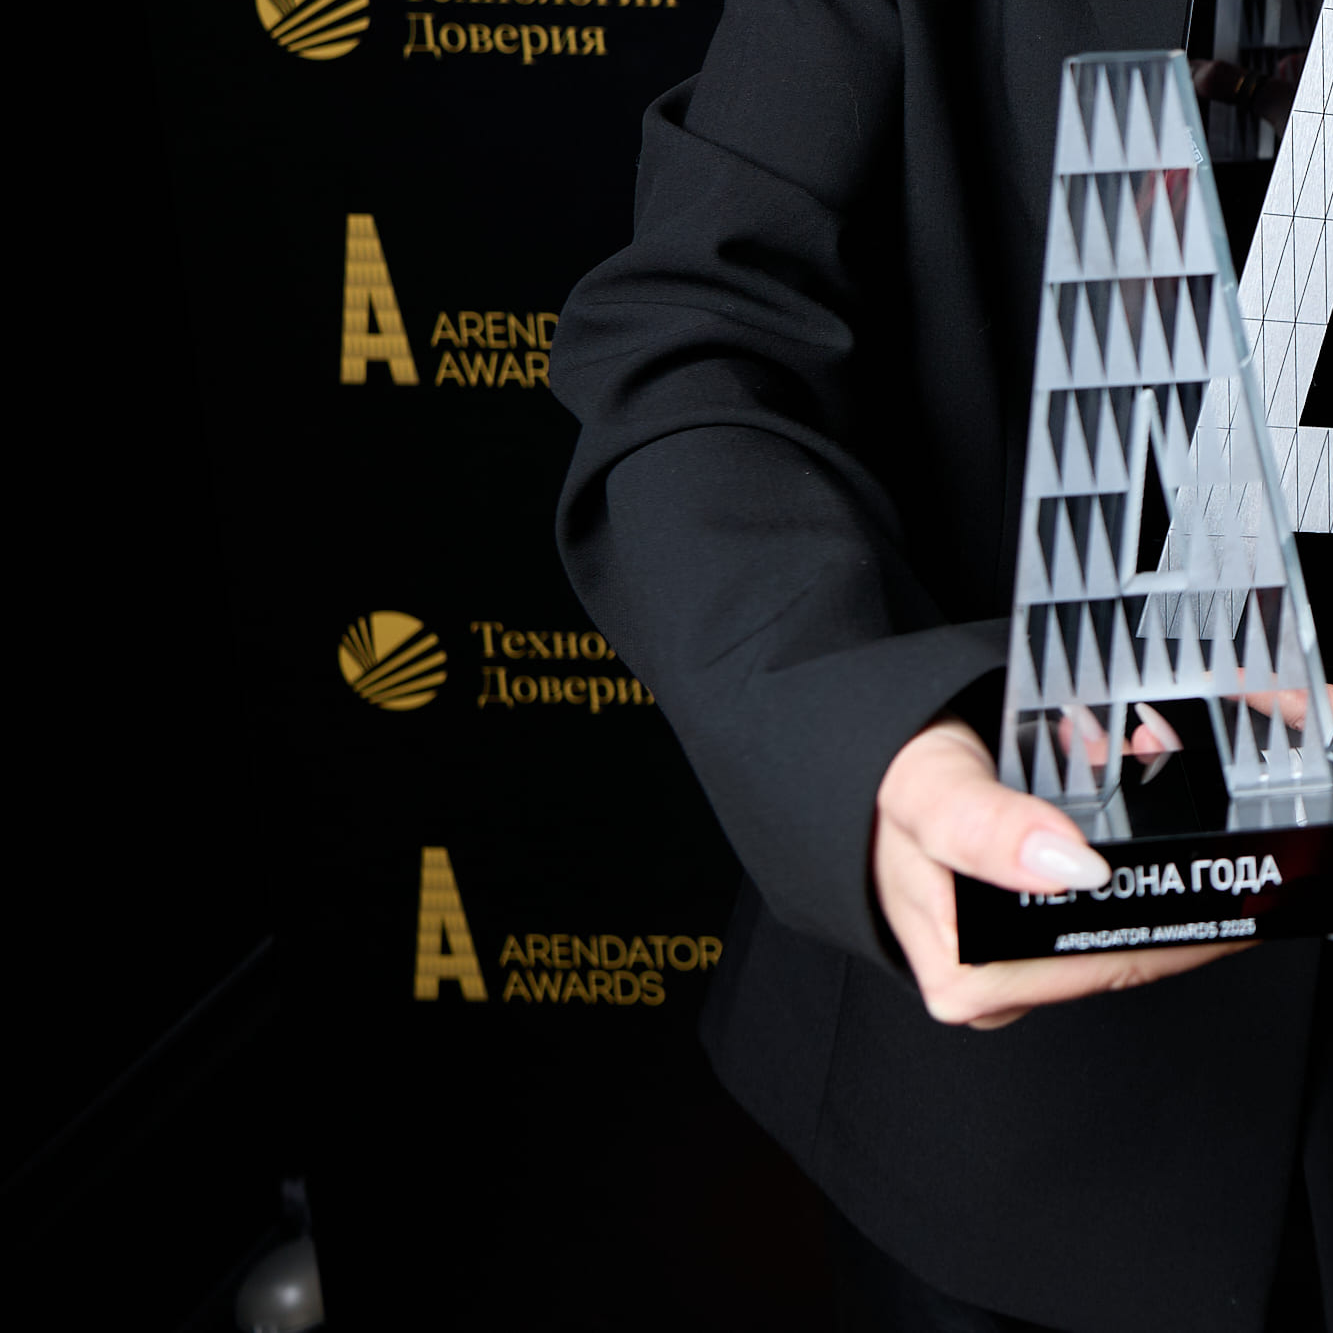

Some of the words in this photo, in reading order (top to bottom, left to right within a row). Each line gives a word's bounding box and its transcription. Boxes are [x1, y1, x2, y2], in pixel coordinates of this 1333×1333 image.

[403, 13, 608, 65] Доверия
[431, 311, 560, 350] AREND
[435, 351, 550, 388] AWAR
[470, 621, 617, 660] Техно
[1190, 854, 1282, 896] ГОДА
[499, 934, 723, 971] ARENDATOR
[1054, 926, 1150, 952] ARENDATOR
[1150, 920, 1218, 944] AWARDS
[1218, 917, 1256, 938] 2025
[503, 970, 666, 1006] AWARDS
